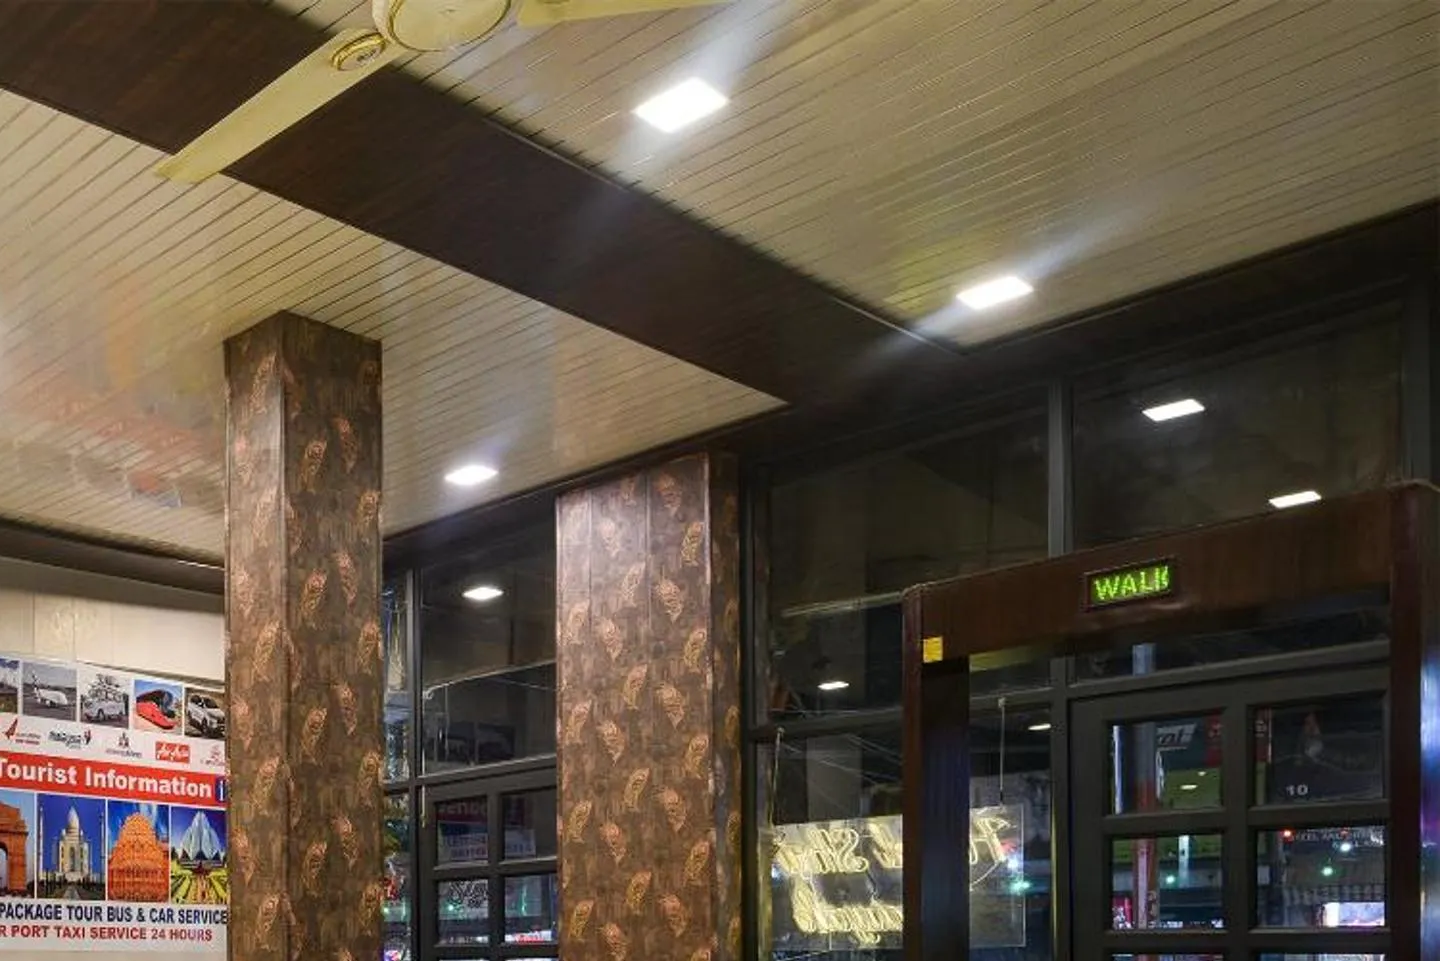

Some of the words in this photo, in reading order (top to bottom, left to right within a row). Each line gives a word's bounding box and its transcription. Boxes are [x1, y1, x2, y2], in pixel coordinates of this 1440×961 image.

[85, 767, 212, 798] Information
[67, 905, 103, 922] TOUR
[107, 905, 133, 922] BUS
[136, 907, 145, 922] &
[150, 907, 174, 923] CAR
[178, 909, 228, 925] SERVICE
[11, 925, 50, 939] PORT
[54, 925, 85, 939] TAXI
[90, 926, 147, 940] SERVICE
[150, 927, 166, 941] 24
[169, 928, 213, 942] HOURS
